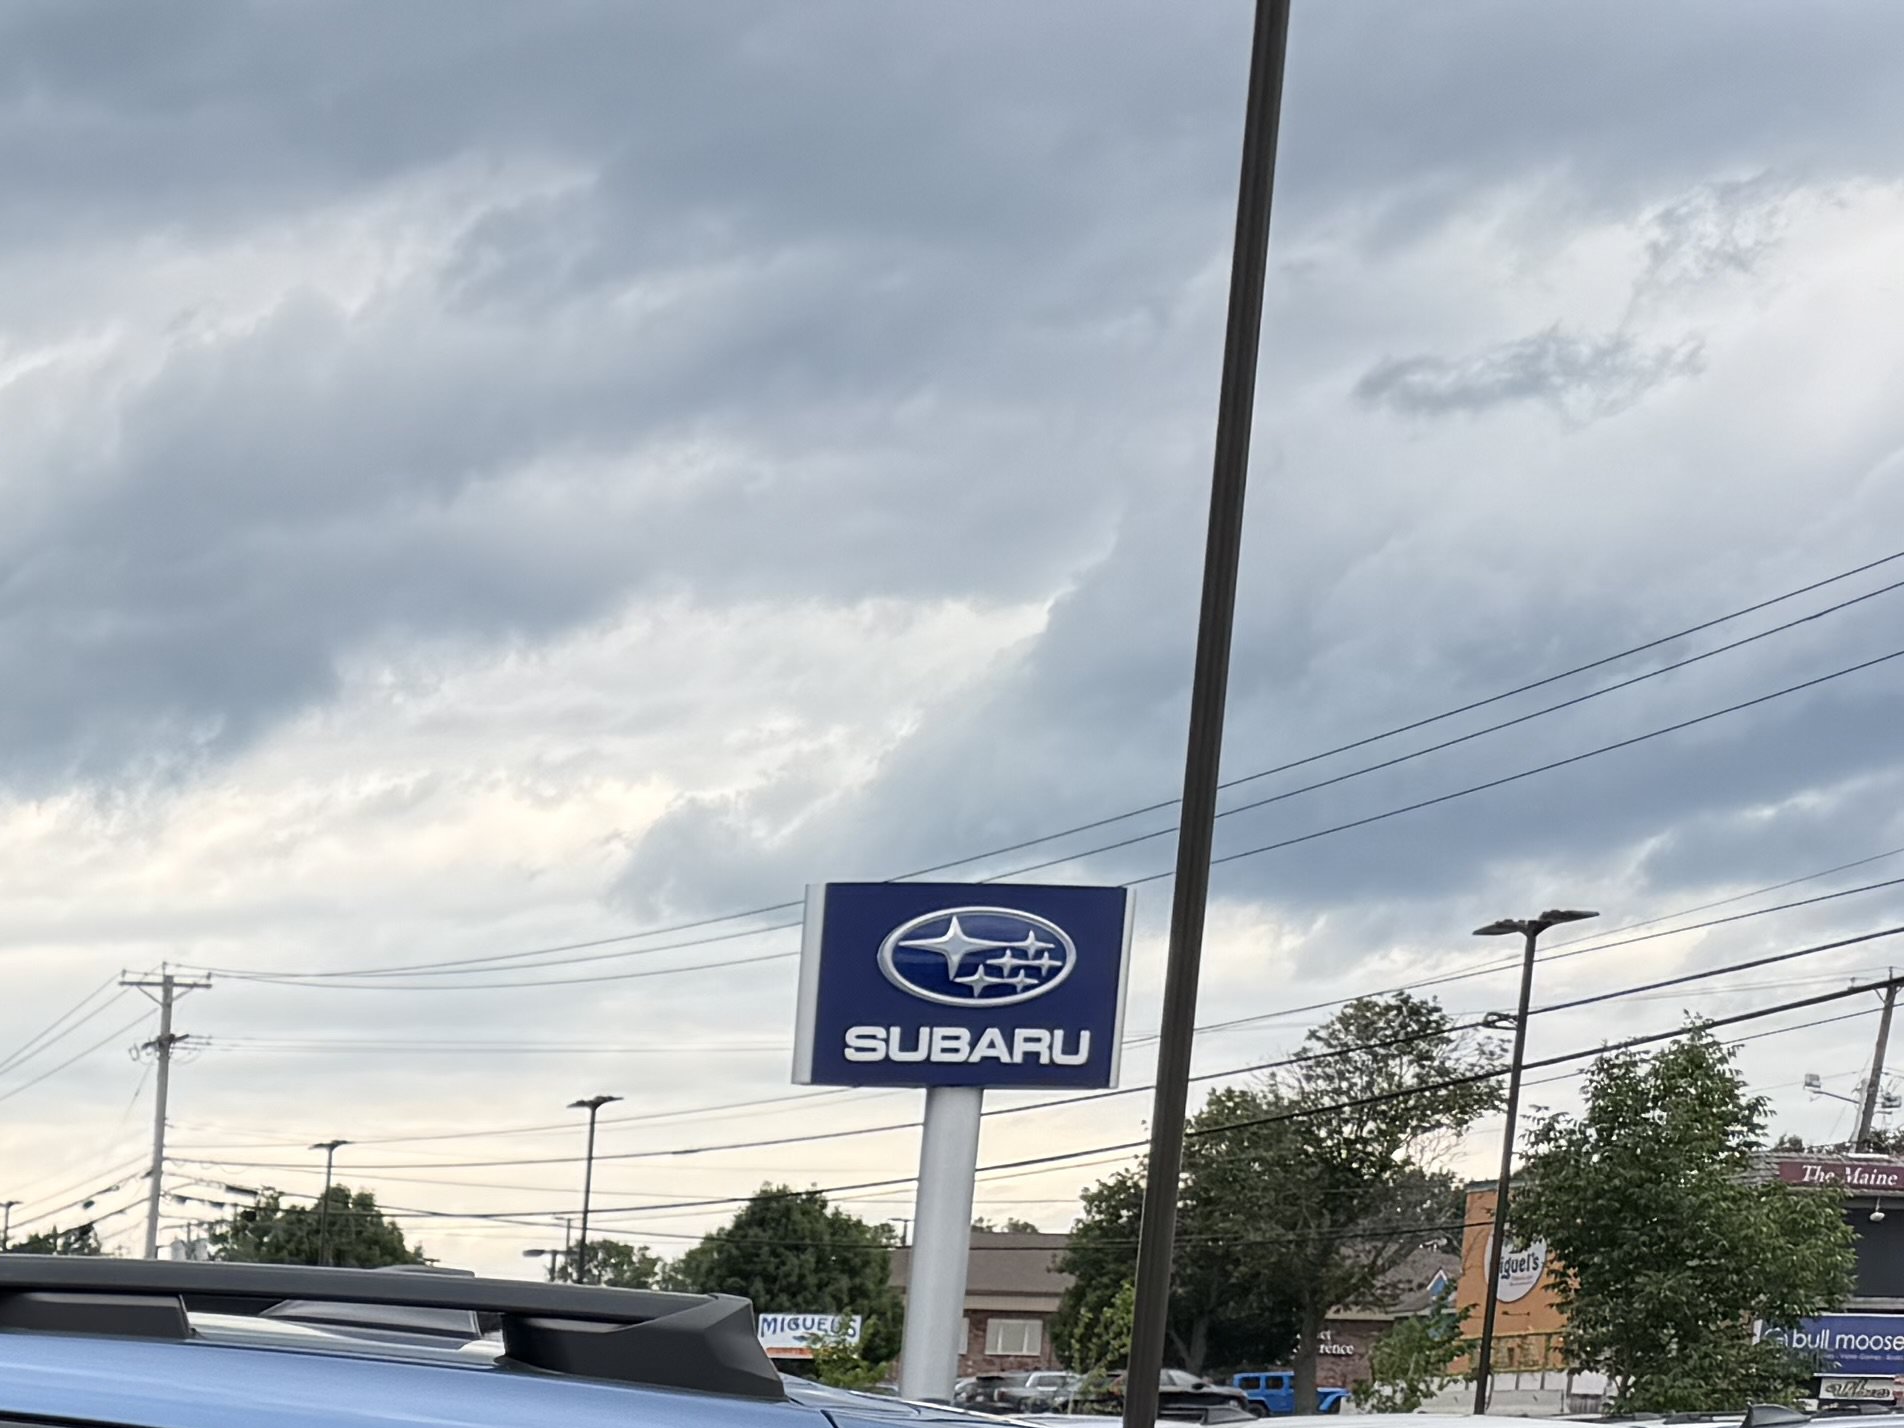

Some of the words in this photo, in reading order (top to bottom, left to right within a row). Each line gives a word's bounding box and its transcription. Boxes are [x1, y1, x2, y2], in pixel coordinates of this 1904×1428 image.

[844, 1026, 1091, 1065] SUBARU
[1802, 1165, 1835, 1183] The
[1845, 1167, 1898, 1185] Maine
[1499, 1252, 1539, 1280] iguel's
[1792, 1329, 1830, 1349] bull
[1835, 1334, 1904, 1351] moose
